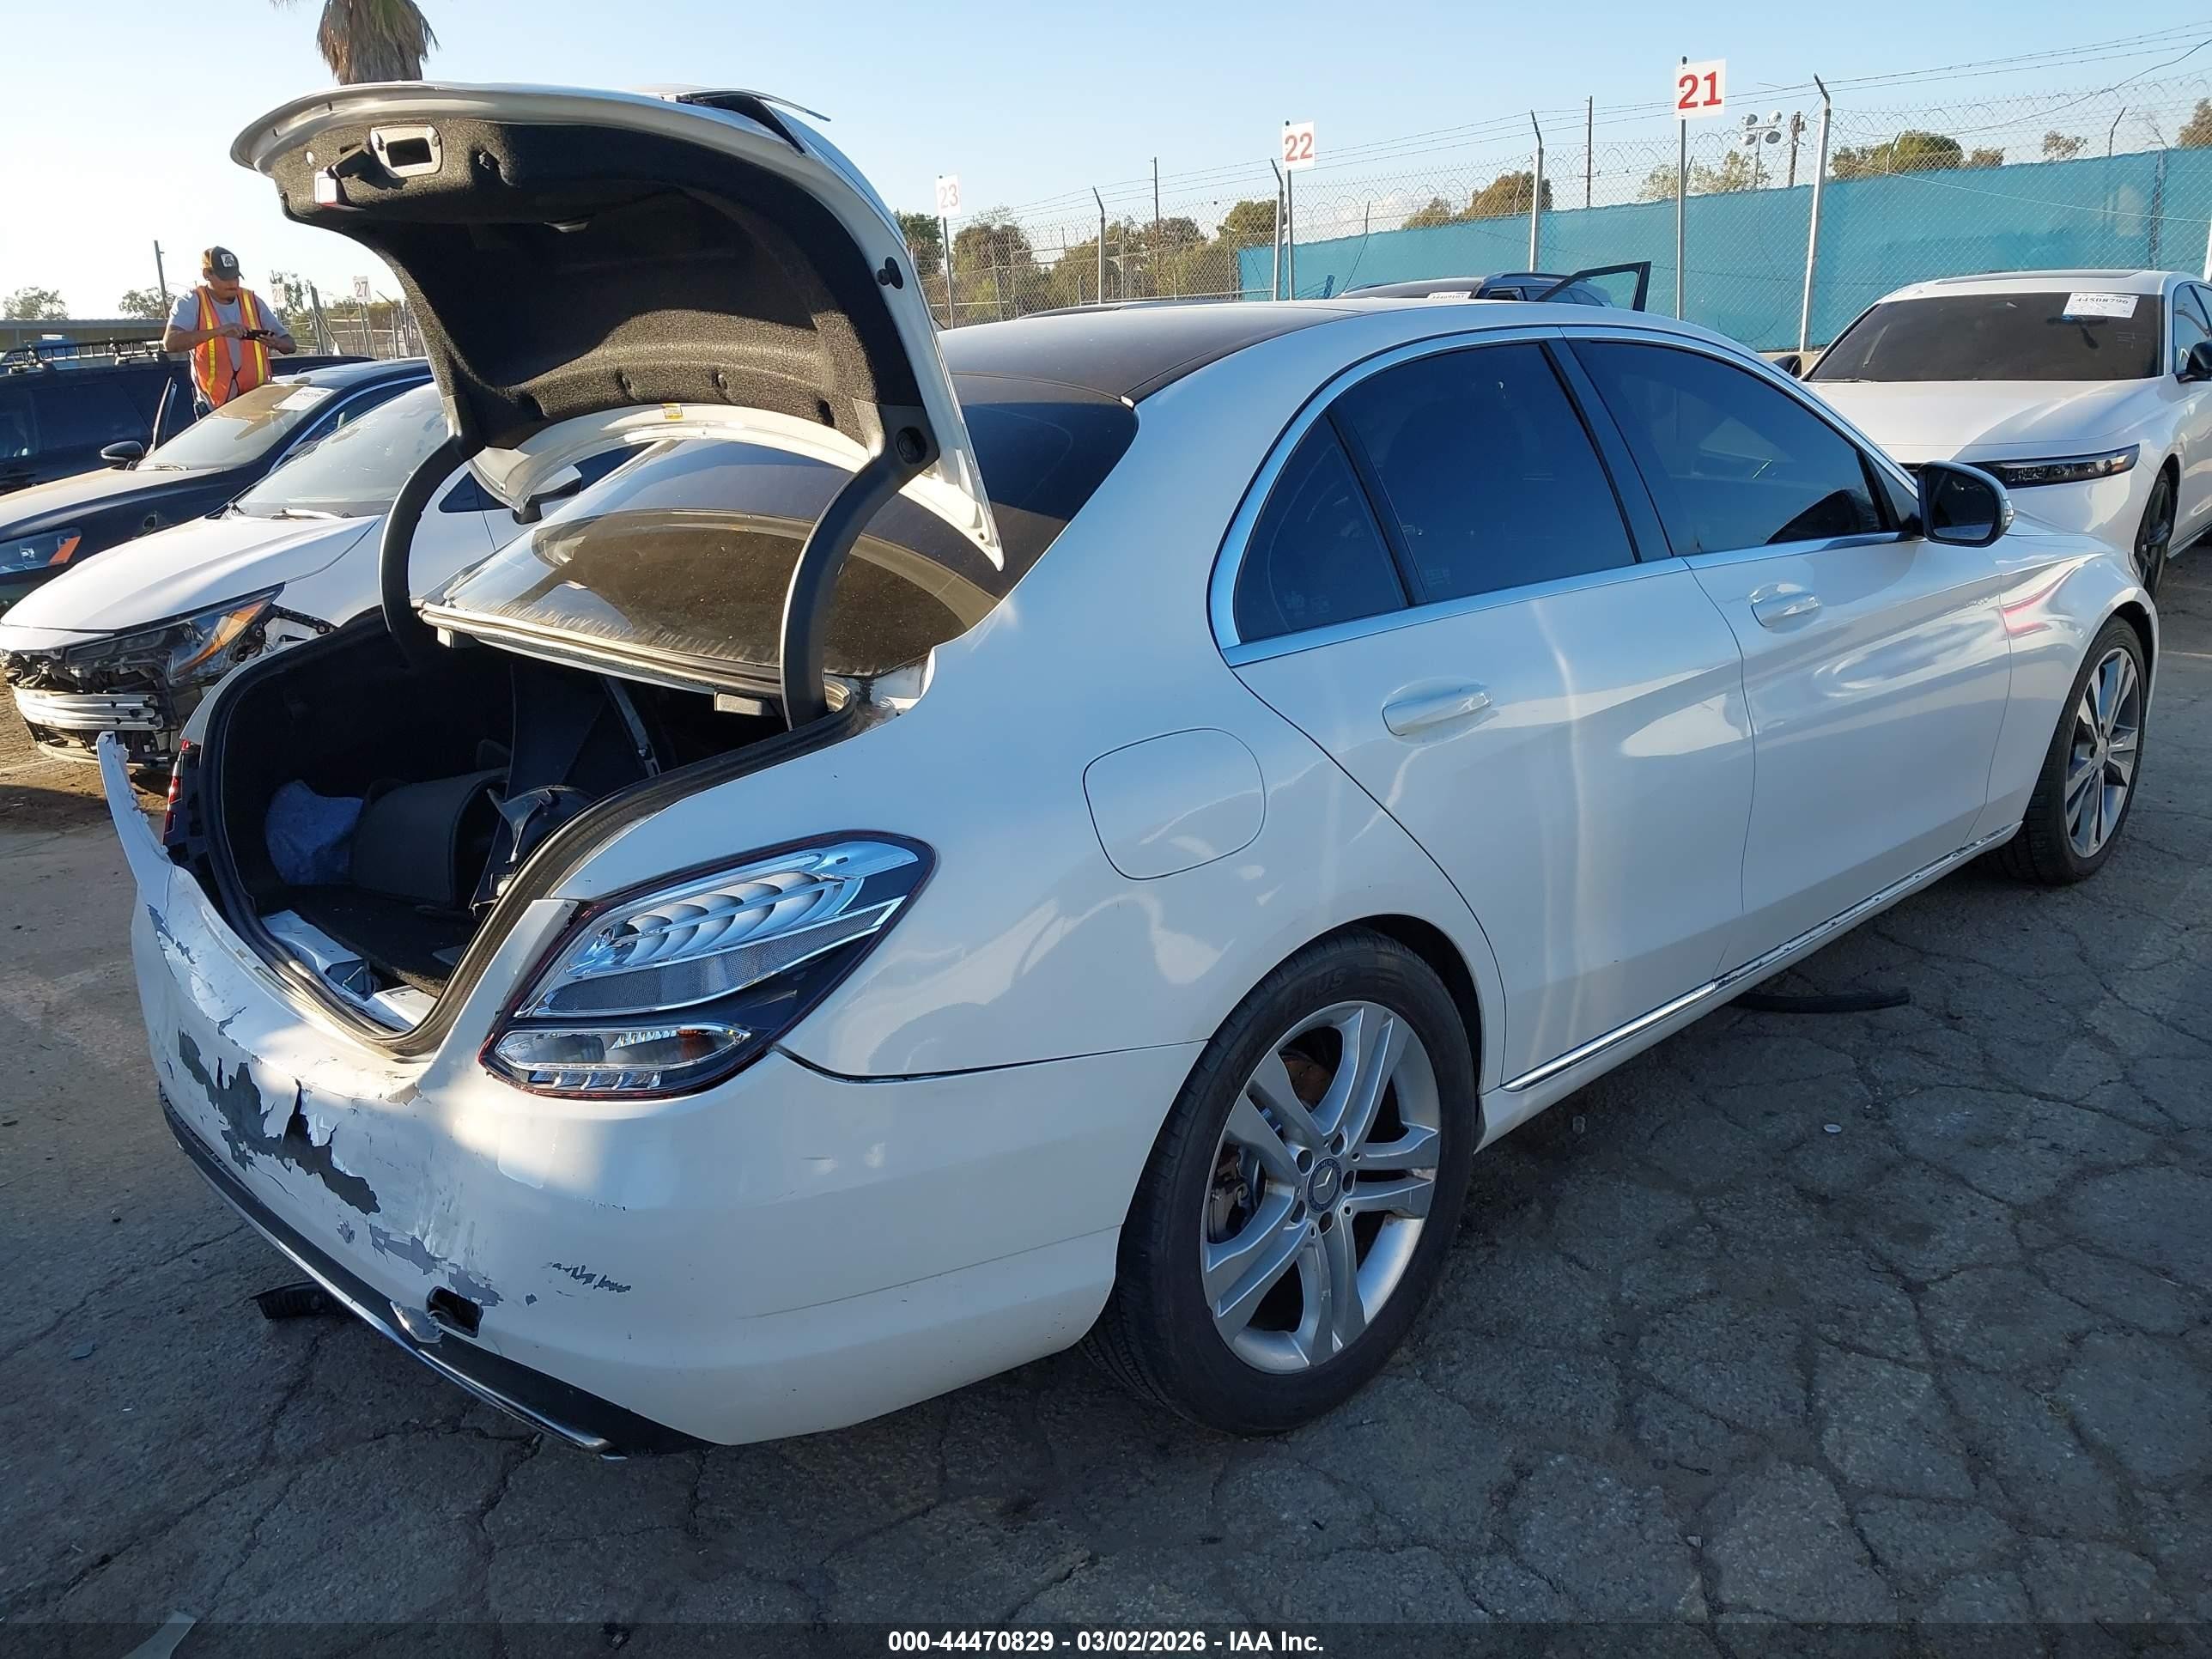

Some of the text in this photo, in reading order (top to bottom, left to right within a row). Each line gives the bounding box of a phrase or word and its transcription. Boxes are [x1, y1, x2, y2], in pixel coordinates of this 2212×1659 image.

[1678, 70, 1722, 110] 21
[1285, 132, 1313, 161] 22
[939, 184, 958, 209] 23
[271, 288, 284, 303] 28
[354, 281, 368, 298] 27
